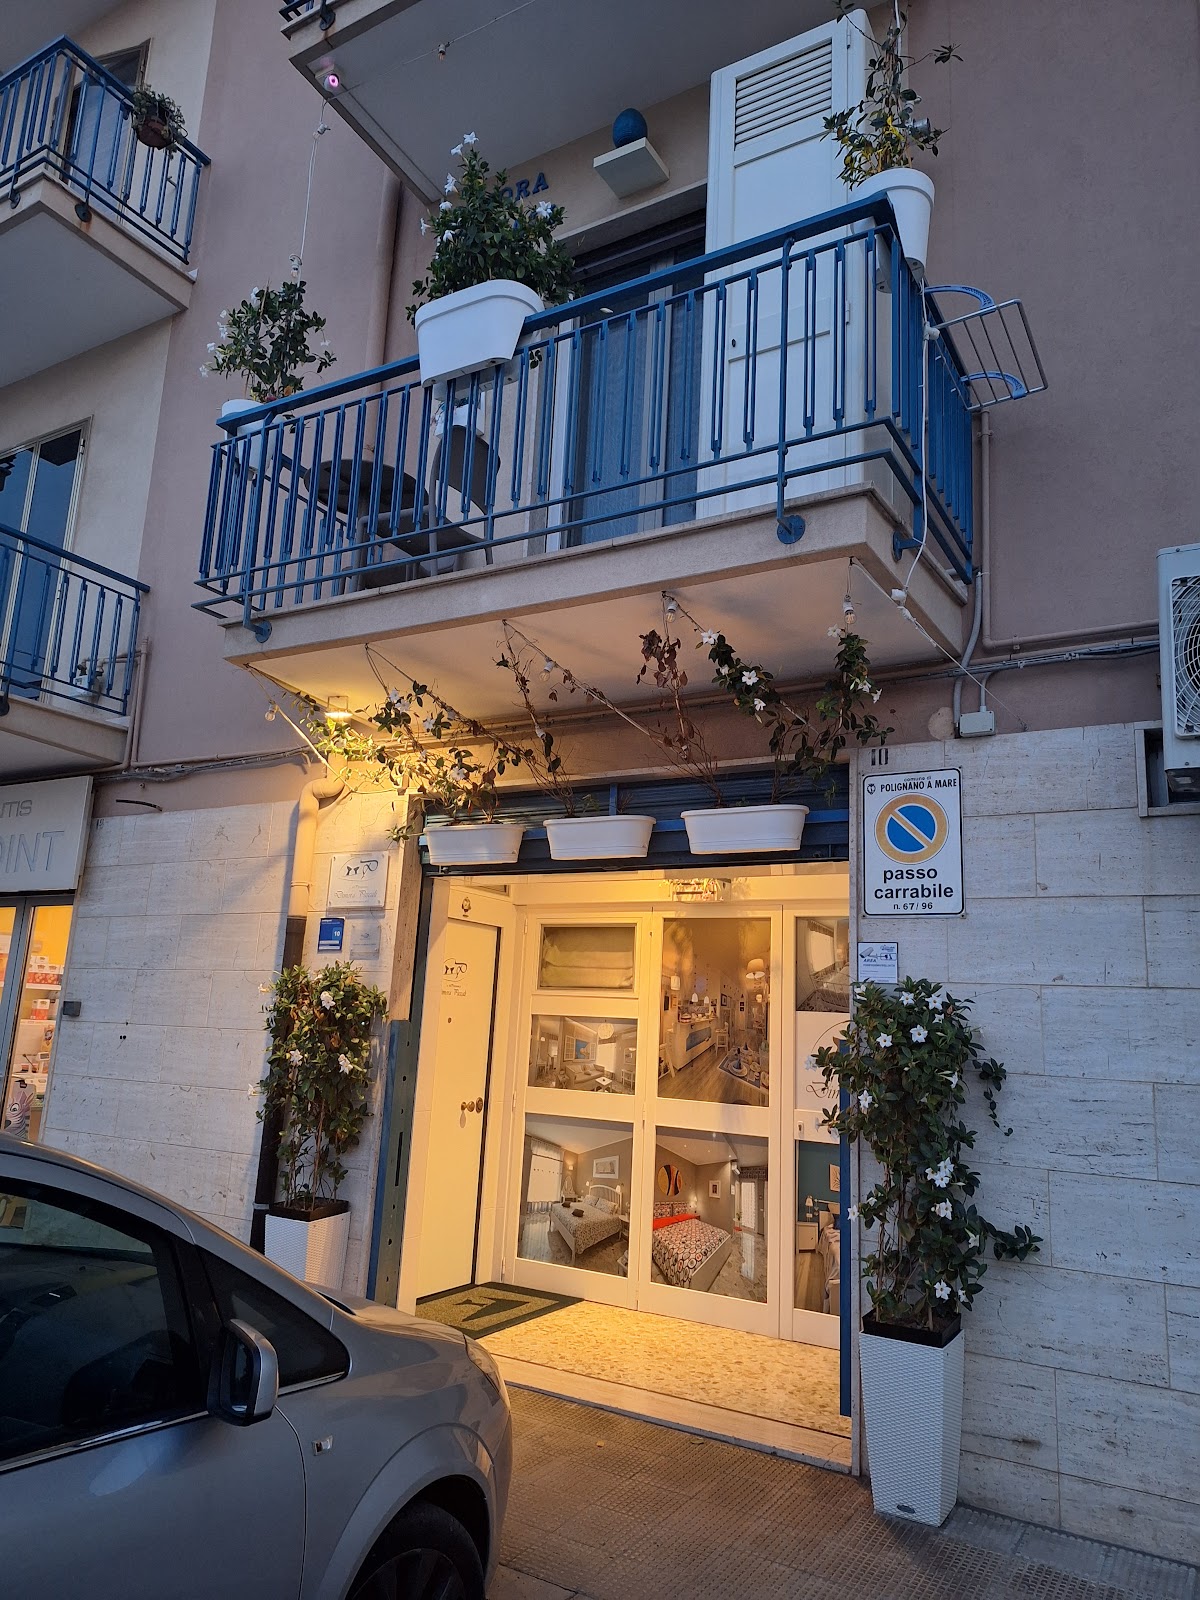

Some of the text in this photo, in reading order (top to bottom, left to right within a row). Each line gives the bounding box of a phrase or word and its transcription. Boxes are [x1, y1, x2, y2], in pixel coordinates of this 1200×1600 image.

[880, 778, 957, 793] POLIGNANO A MARE
[883, 868, 938, 883] passo
[874, 883, 954, 899] carrabile
